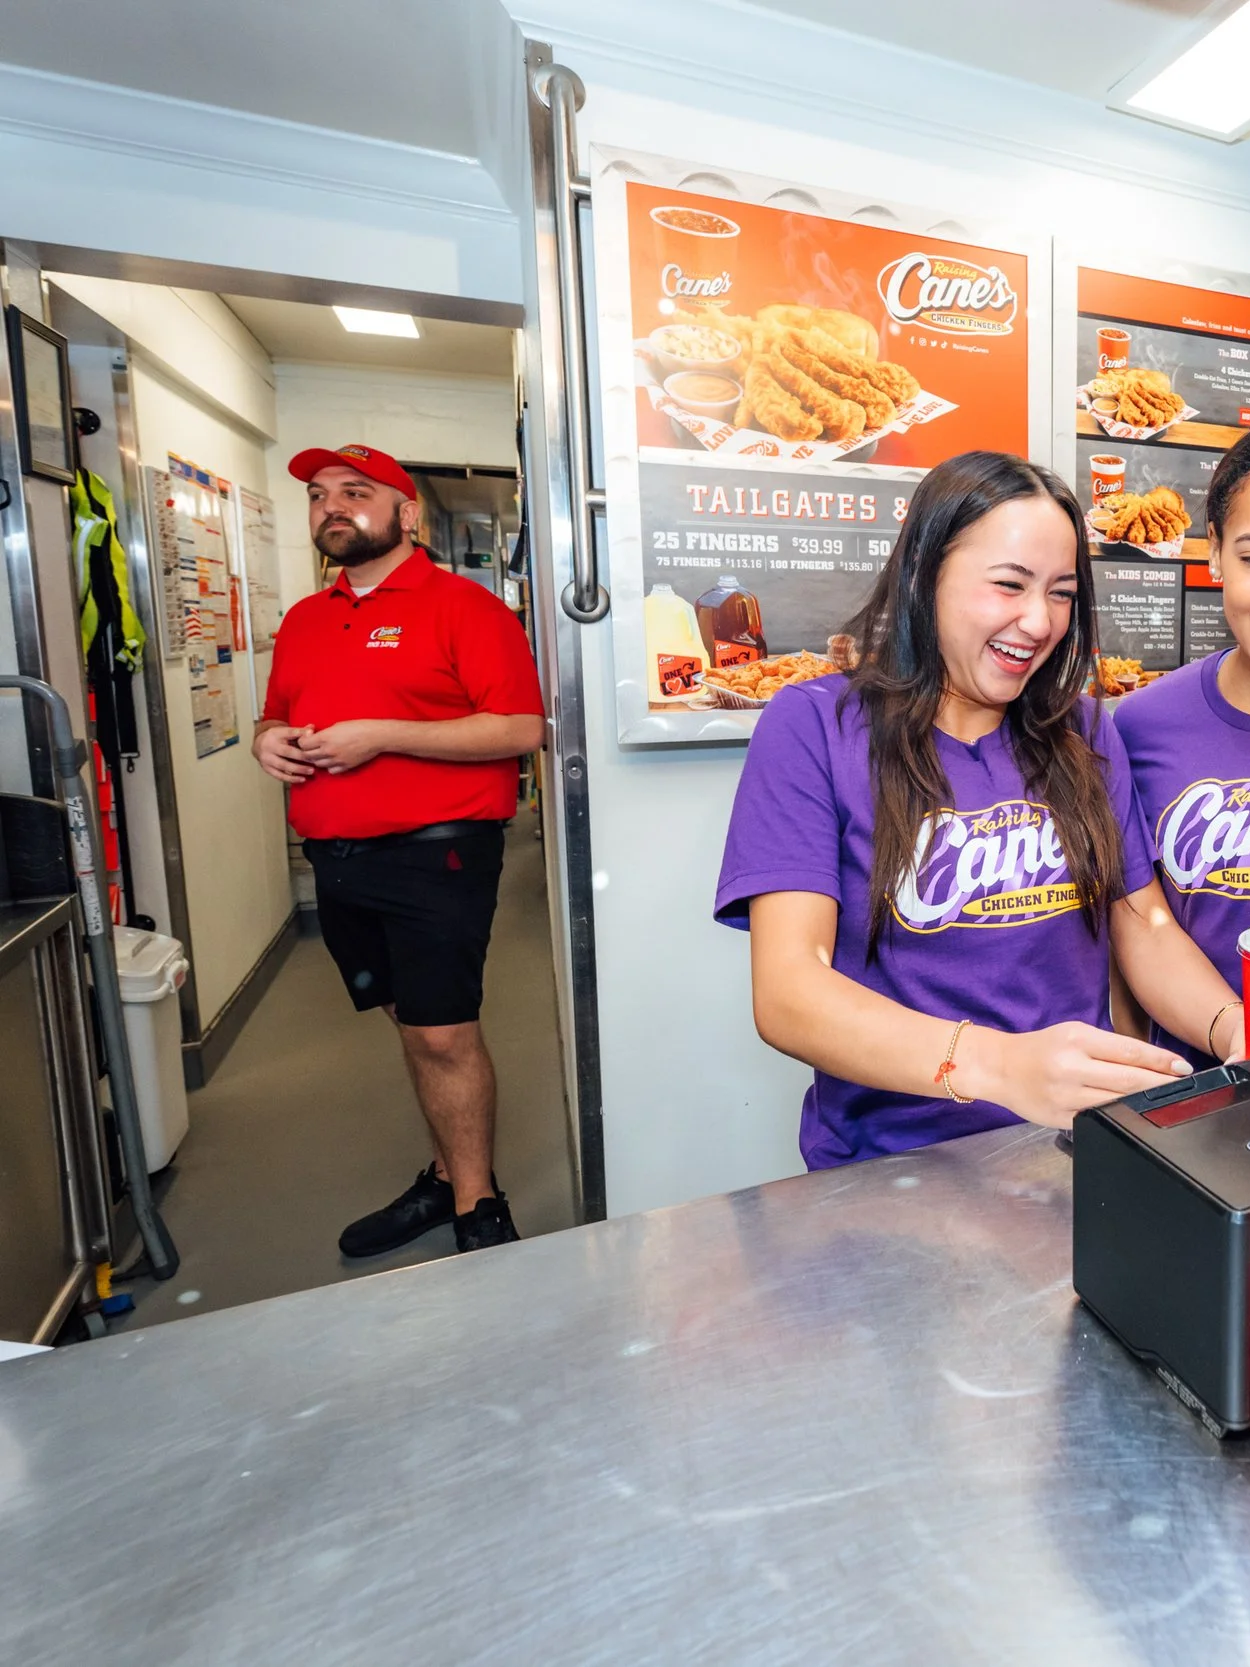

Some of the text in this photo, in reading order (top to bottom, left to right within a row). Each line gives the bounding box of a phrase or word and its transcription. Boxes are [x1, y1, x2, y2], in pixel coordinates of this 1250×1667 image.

[934, 261, 978, 281] Raising
[661, 263, 732, 299] Cane's
[887, 254, 1014, 320] Cane's
[931, 313, 1002, 332] CHICKEN FINGERS
[1218, 349, 1230, 357] The
[1230, 348, 1249, 360] BOX
[1221, 366, 1226, 375] 4
[1093, 478, 1122, 495] Cane's
[686, 484, 876, 521] TAILGATES
[653, 532, 891, 556] 25 FINGERS $39.99 50
[656, 557, 671, 566] 75
[672, 558, 721, 568] FINGERS
[726, 559, 762, 569] $113.16
[770, 560, 788, 569] 100
[789, 561, 835, 571] FINGERS
[840, 561, 873, 572] $135.80
[1104, 569, 1175, 581] The KIDS COMBO
[1110, 594, 1175, 605] 2 Chicken Fingers
[720, 657, 740, 667] ONE
[664, 669, 683, 681] ONE
[971, 809, 1041, 836] Raising
[981, 889, 1042, 912] CHICKEN
